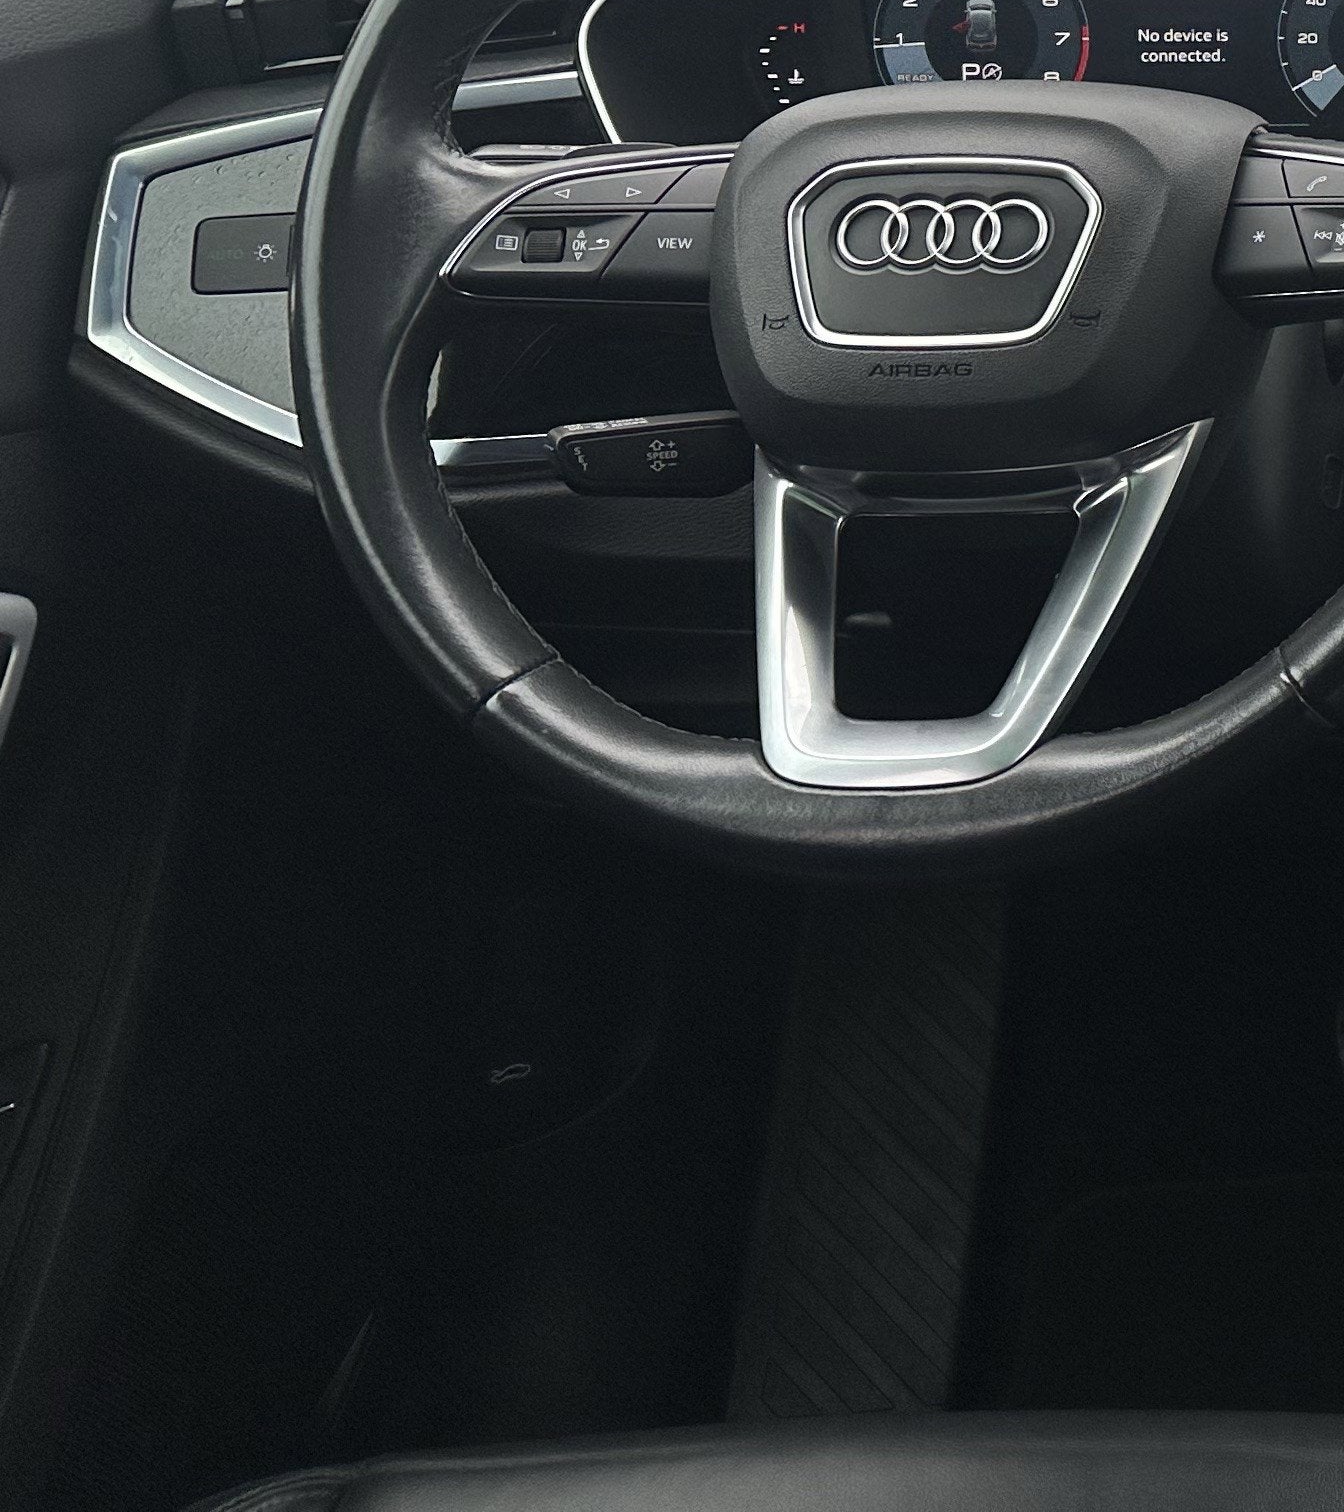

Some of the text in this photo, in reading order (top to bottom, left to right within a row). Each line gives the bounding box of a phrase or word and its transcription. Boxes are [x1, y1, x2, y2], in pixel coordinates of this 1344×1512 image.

[793, 23, 807, 33] H
[896, 33, 904, 46] 1
[1054, 32, 1070, 46] 7
[1138, 29, 1229, 43] No device is
[1297, 33, 1318, 44] 20
[1140, 49, 1226, 63] connected.
[897, 74, 933, 82] READY
[962, 64, 979, 81] P
[572, 238, 587, 251] OK
[656, 237, 693, 250] VIEW
[867, 363, 974, 378] AIRBAG
[574, 447, 588, 471] SET
[646, 450, 678, 461] SPEED
